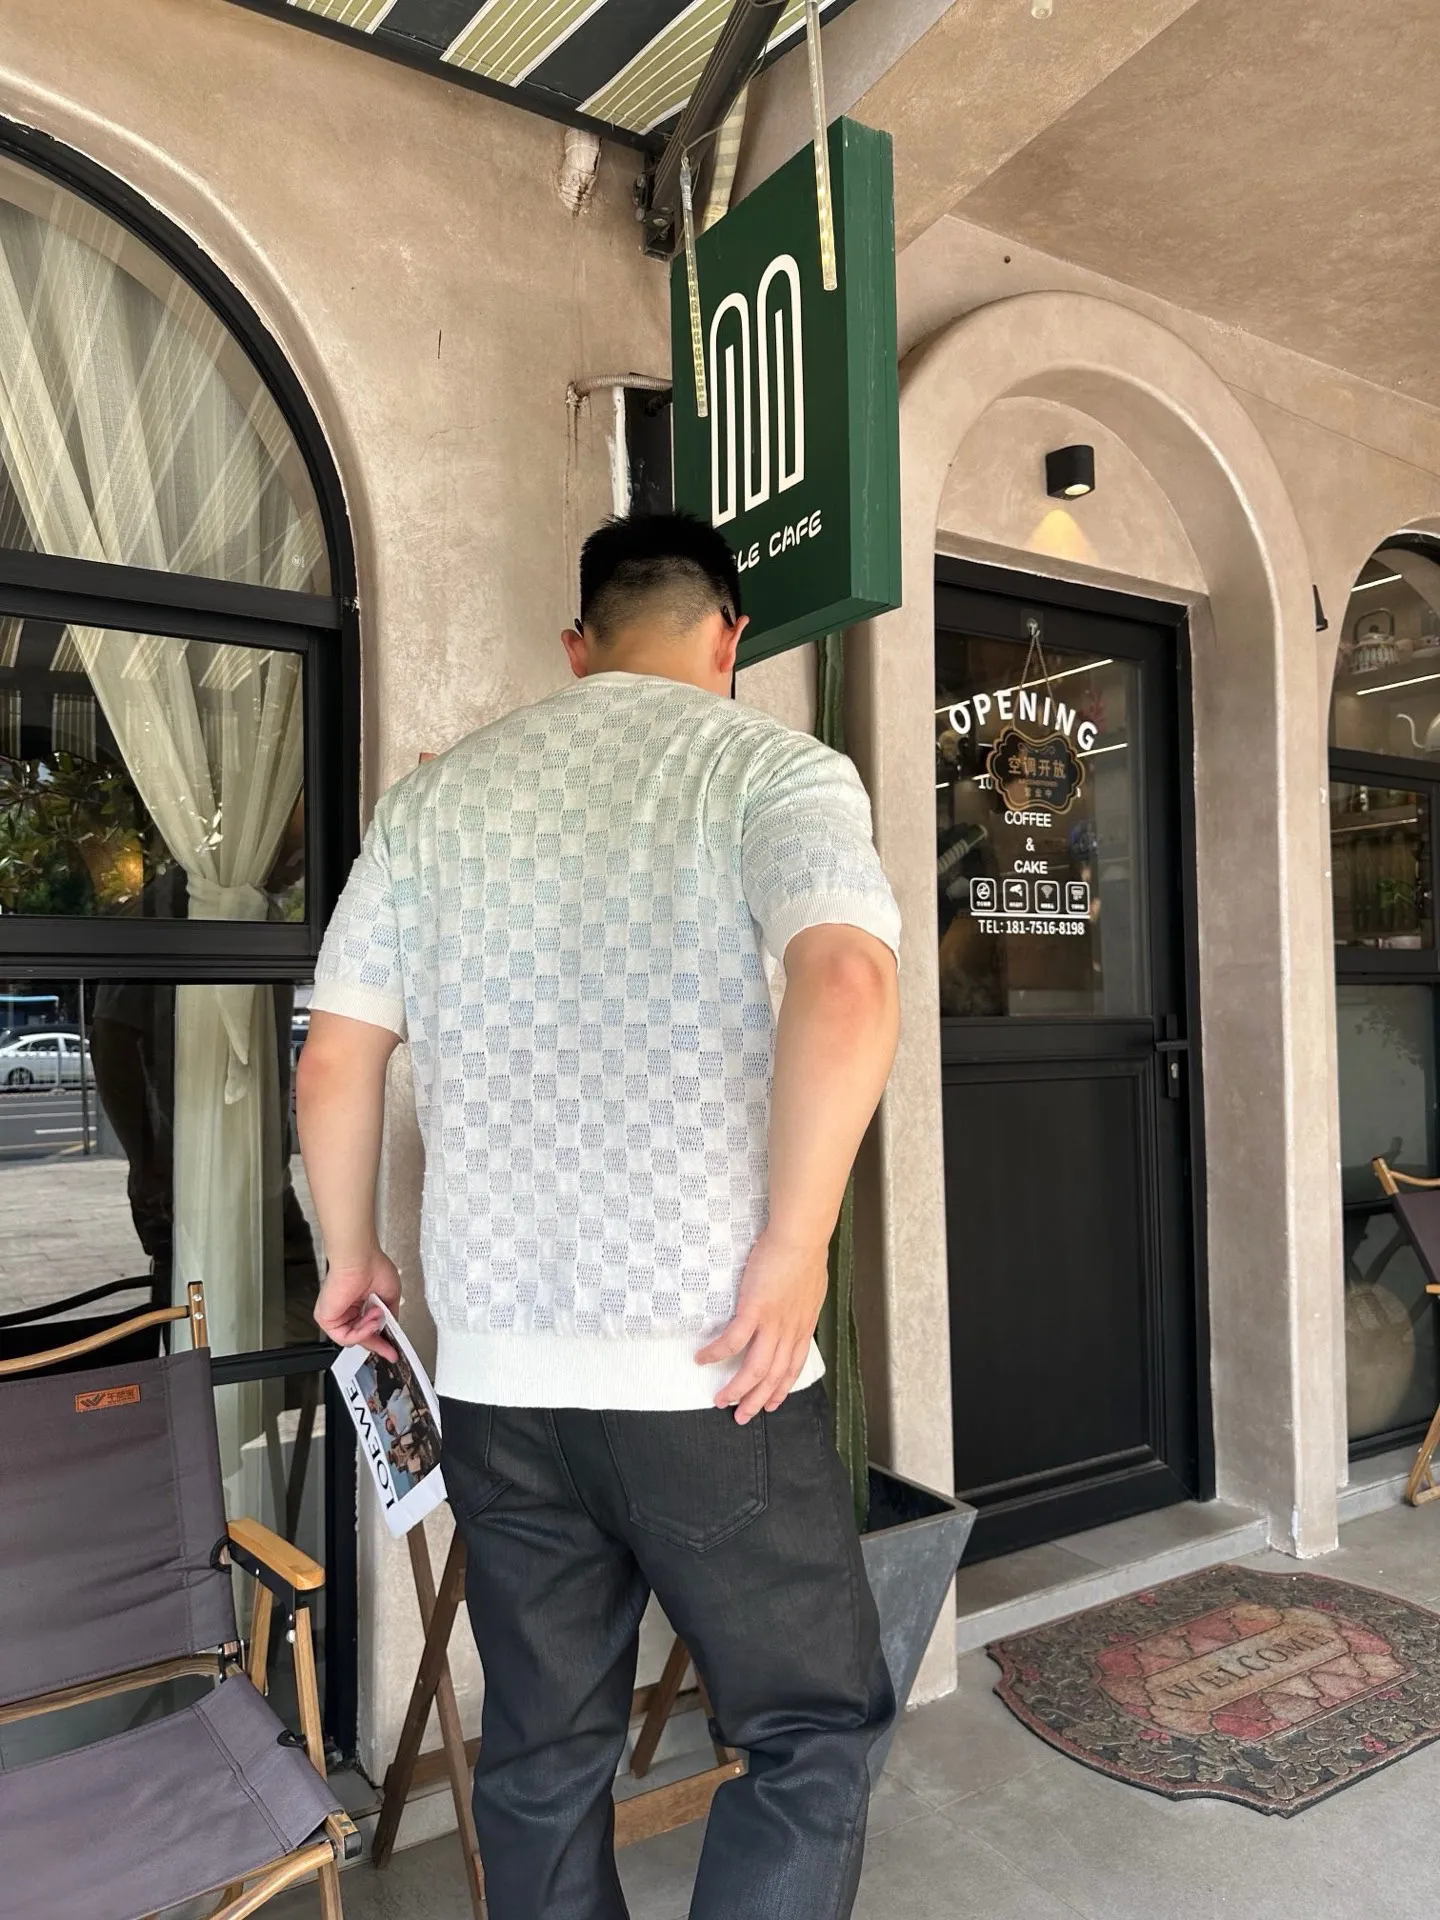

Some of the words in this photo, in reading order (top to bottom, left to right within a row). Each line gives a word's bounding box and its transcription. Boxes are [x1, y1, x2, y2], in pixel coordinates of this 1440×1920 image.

[732, 542, 760, 573] LE
[769, 509, 823, 558] CAFE
[949, 690, 1098, 751] OPENING
[1008, 755, 1067, 779] 空调开放
[1004, 810, 1052, 828] COFFEE
[1025, 837, 1035, 852] &
[1014, 859, 1048, 875] CAKE
[346, 1379, 396, 1509] LOEWE
[1159, 1630, 1337, 1700] WELCOME
